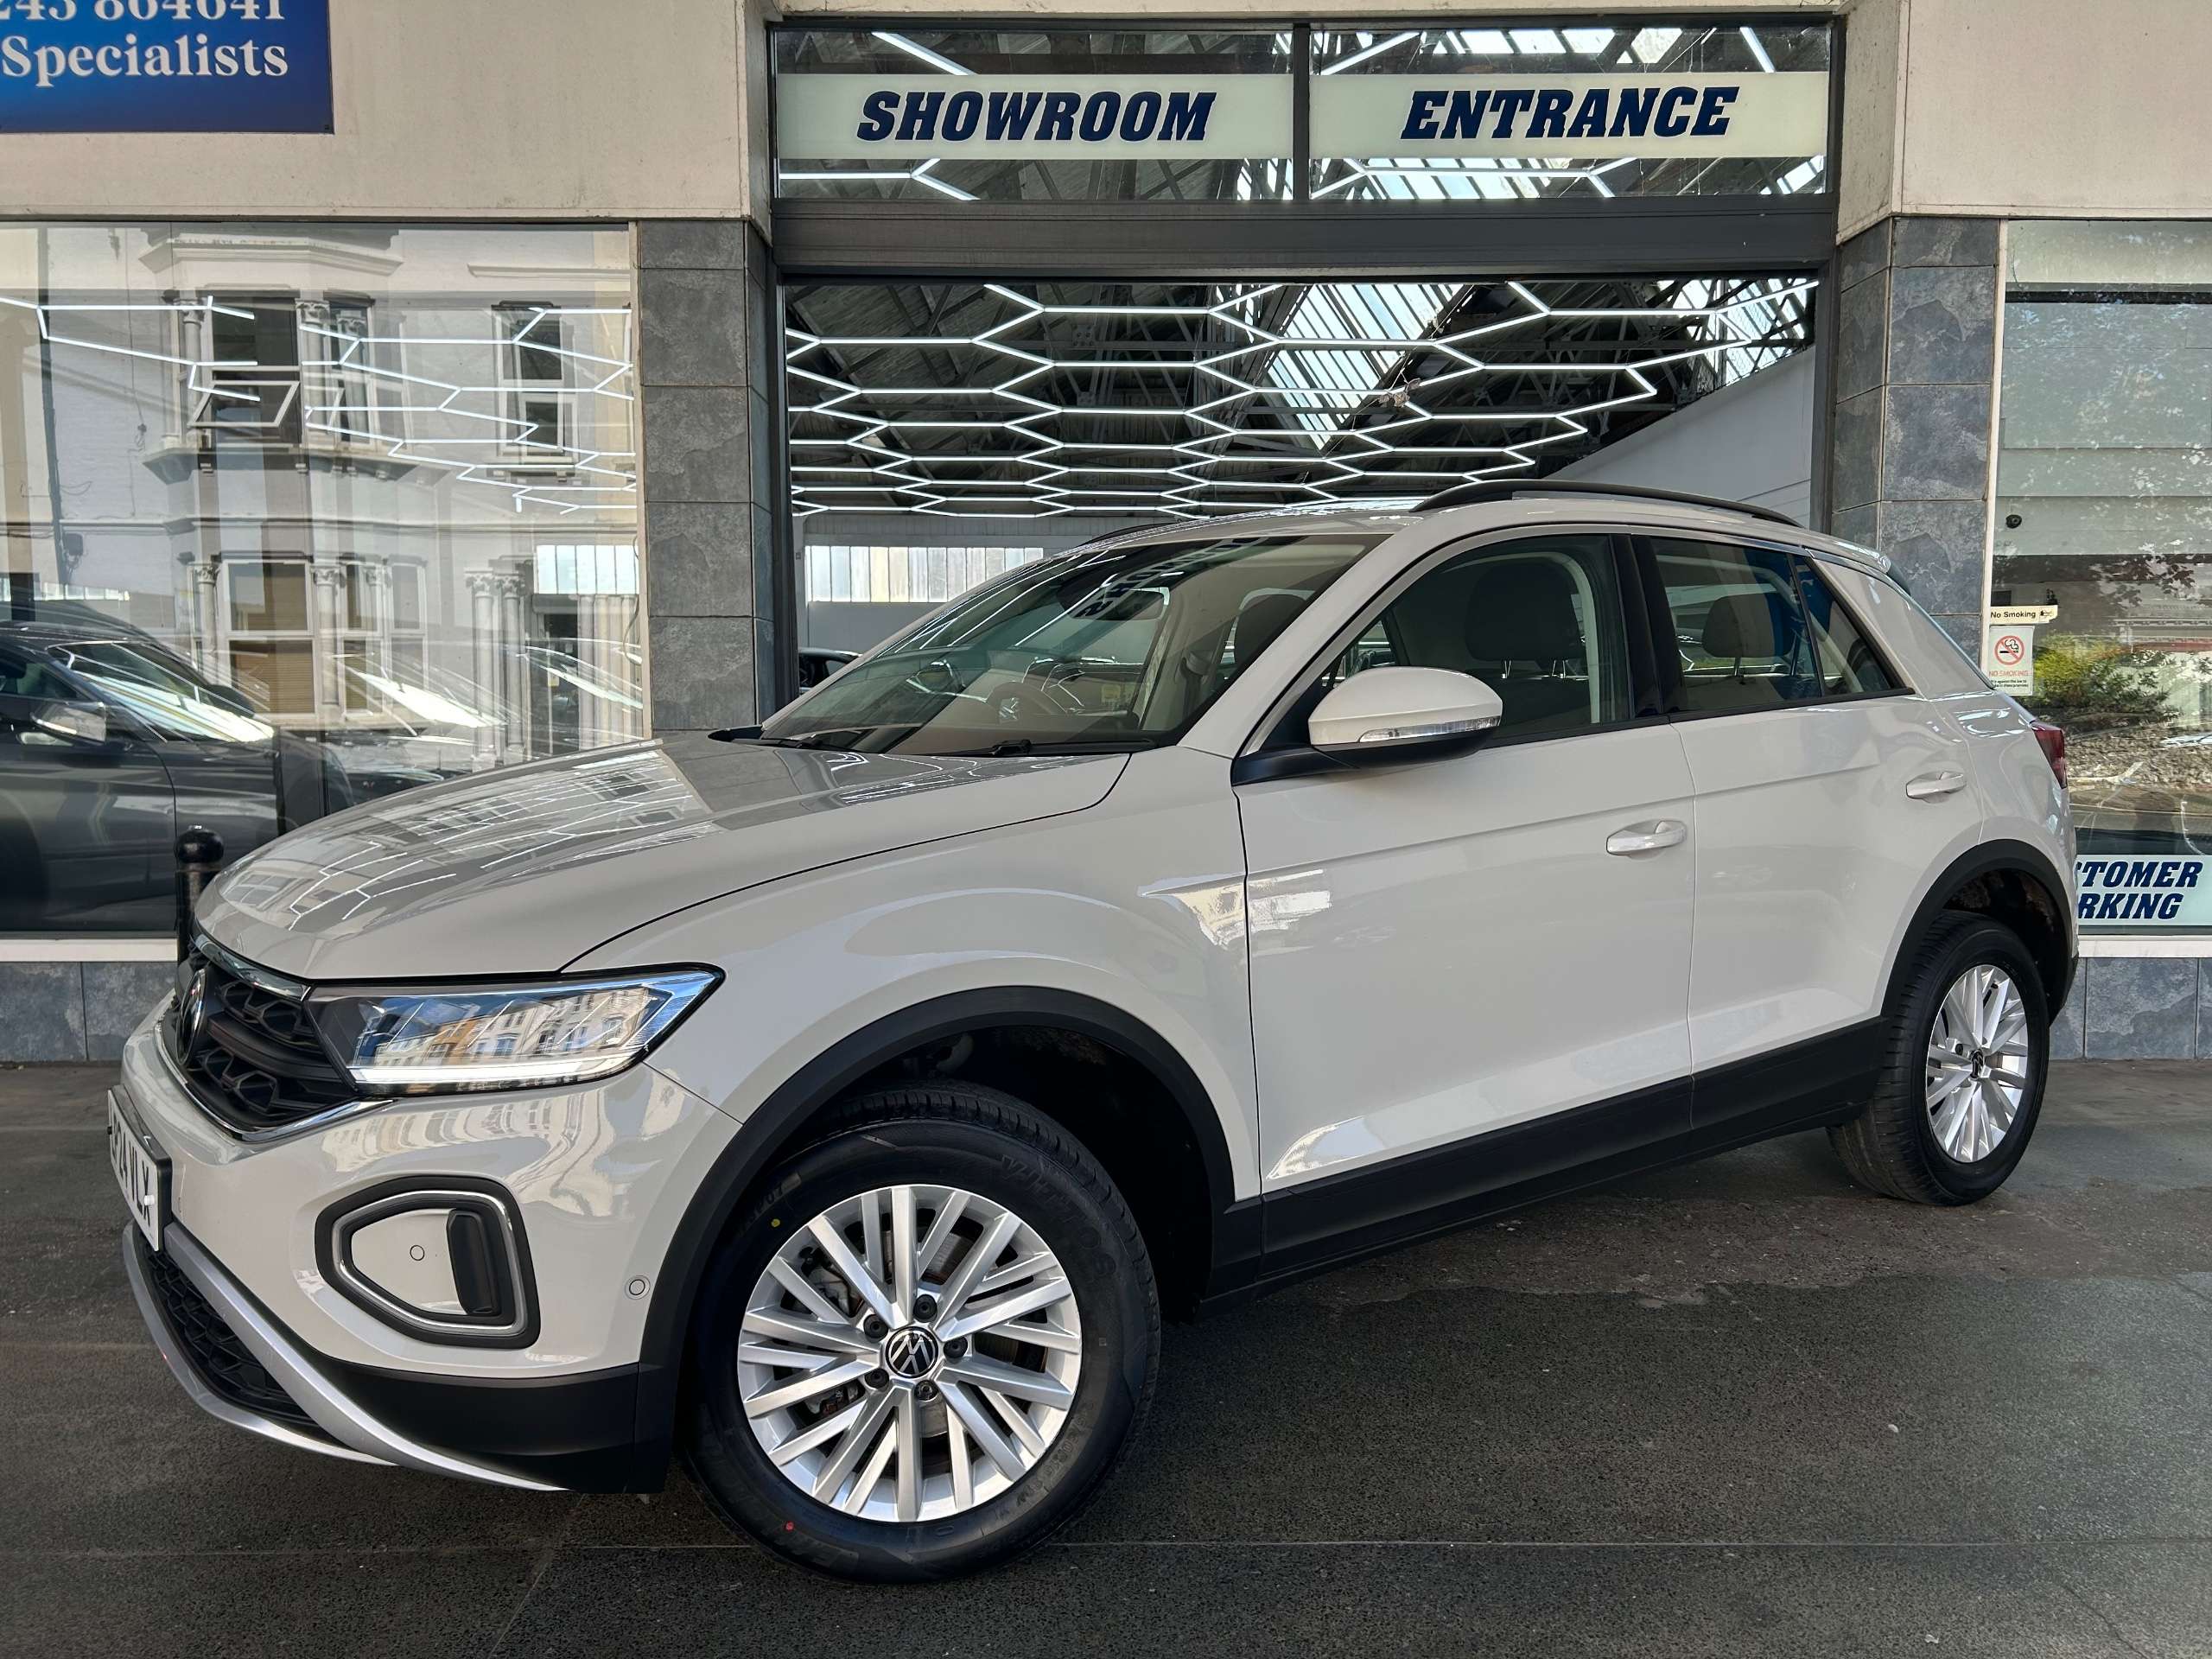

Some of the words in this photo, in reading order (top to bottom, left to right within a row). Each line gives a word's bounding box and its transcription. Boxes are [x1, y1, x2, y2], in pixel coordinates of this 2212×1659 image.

[1, 33, 289, 87] Specialists
[856, 91, 1217, 142] SHOWROOM
[1400, 86, 1740, 140] ENTRANCE
[2077, 861, 2204, 888] TOMER
